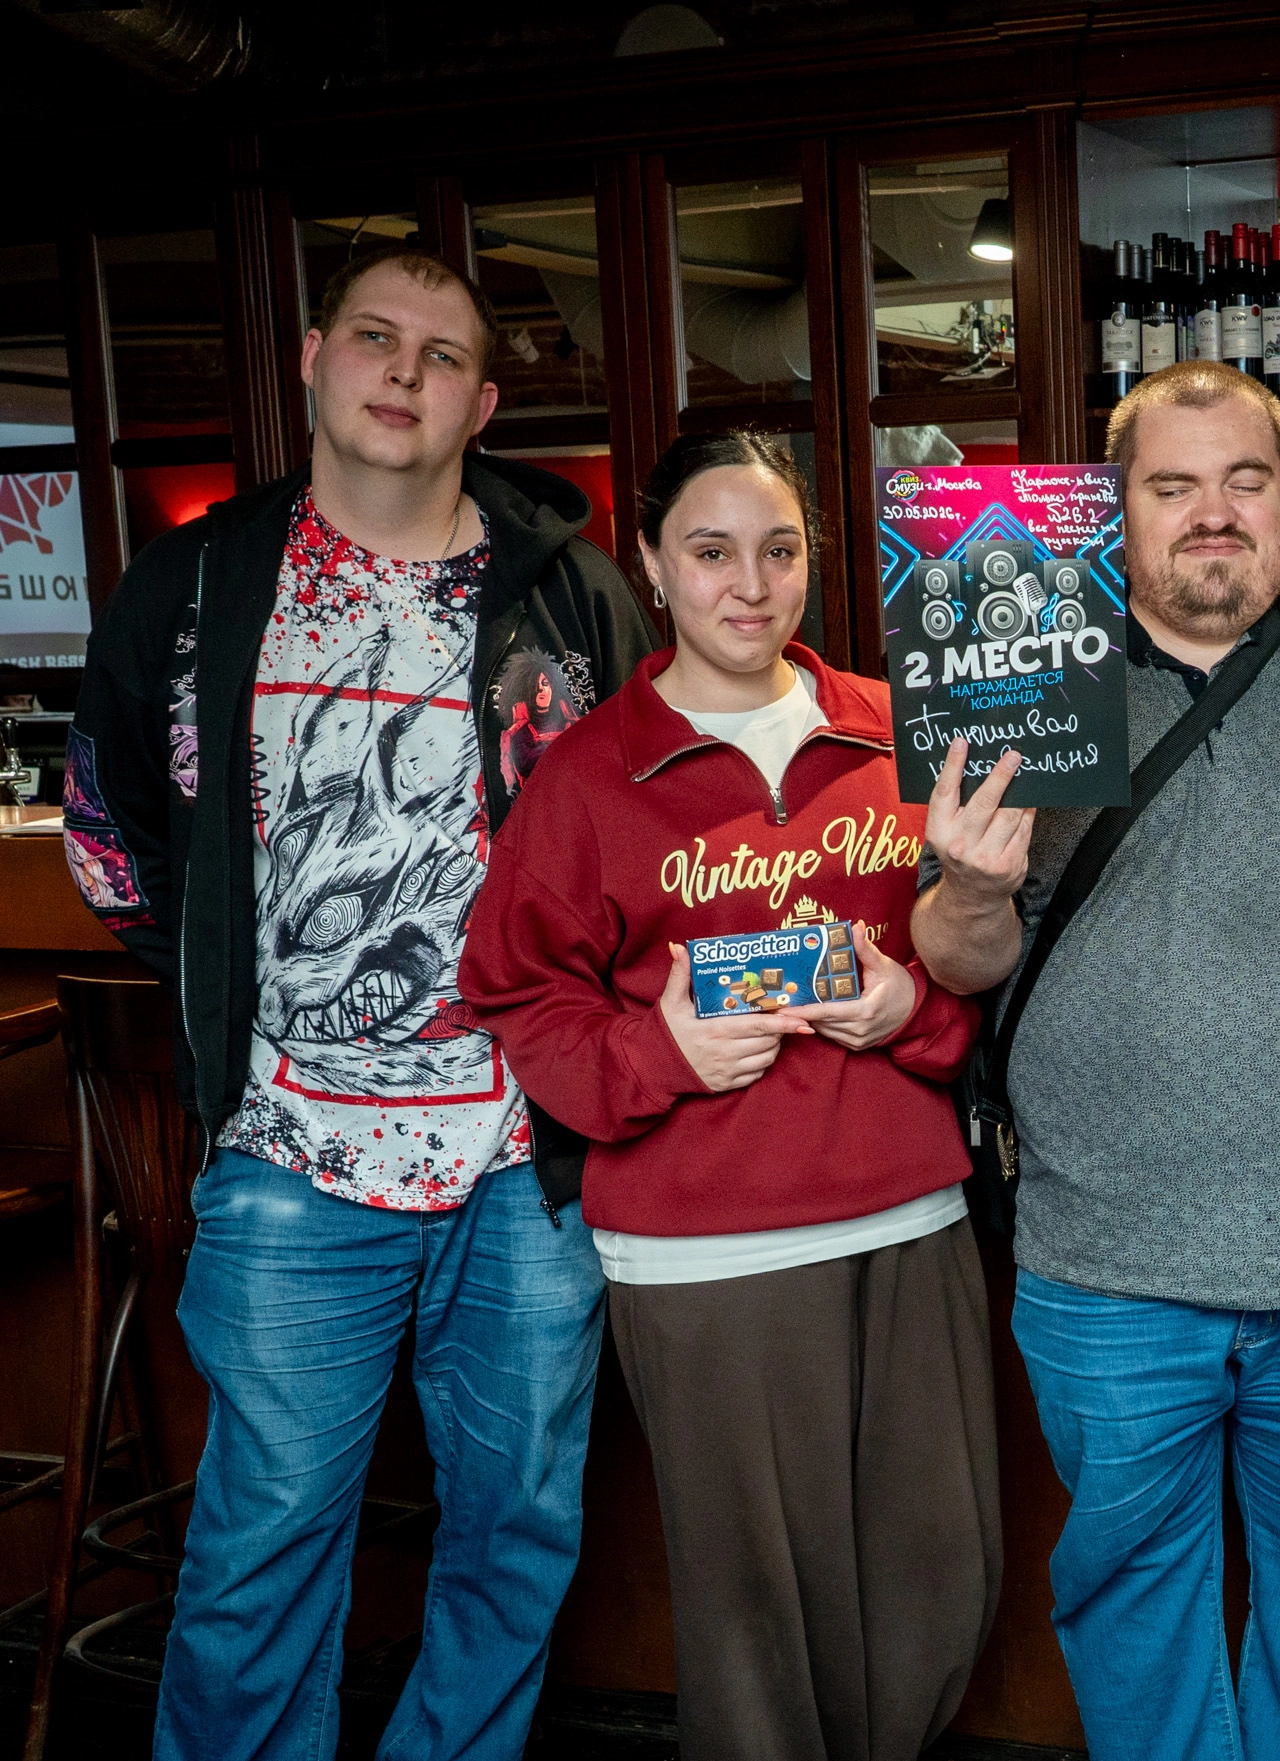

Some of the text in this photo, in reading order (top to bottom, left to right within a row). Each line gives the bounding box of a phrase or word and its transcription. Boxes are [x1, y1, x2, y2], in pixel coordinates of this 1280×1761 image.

[886, 478, 924, 494] Смузи
[1027, 519, 1048, 533] все
[905, 626, 1110, 688] 2 МЕСТО
[950, 670, 1064, 698] НАГРАЖДАЕТСЯ
[971, 689, 1045, 710] КОМАНДА
[660, 807, 922, 910] Vintage Vibes
[693, 932, 800, 964] Schogetten
[697, 964, 747, 976] Praliné Noisettes
